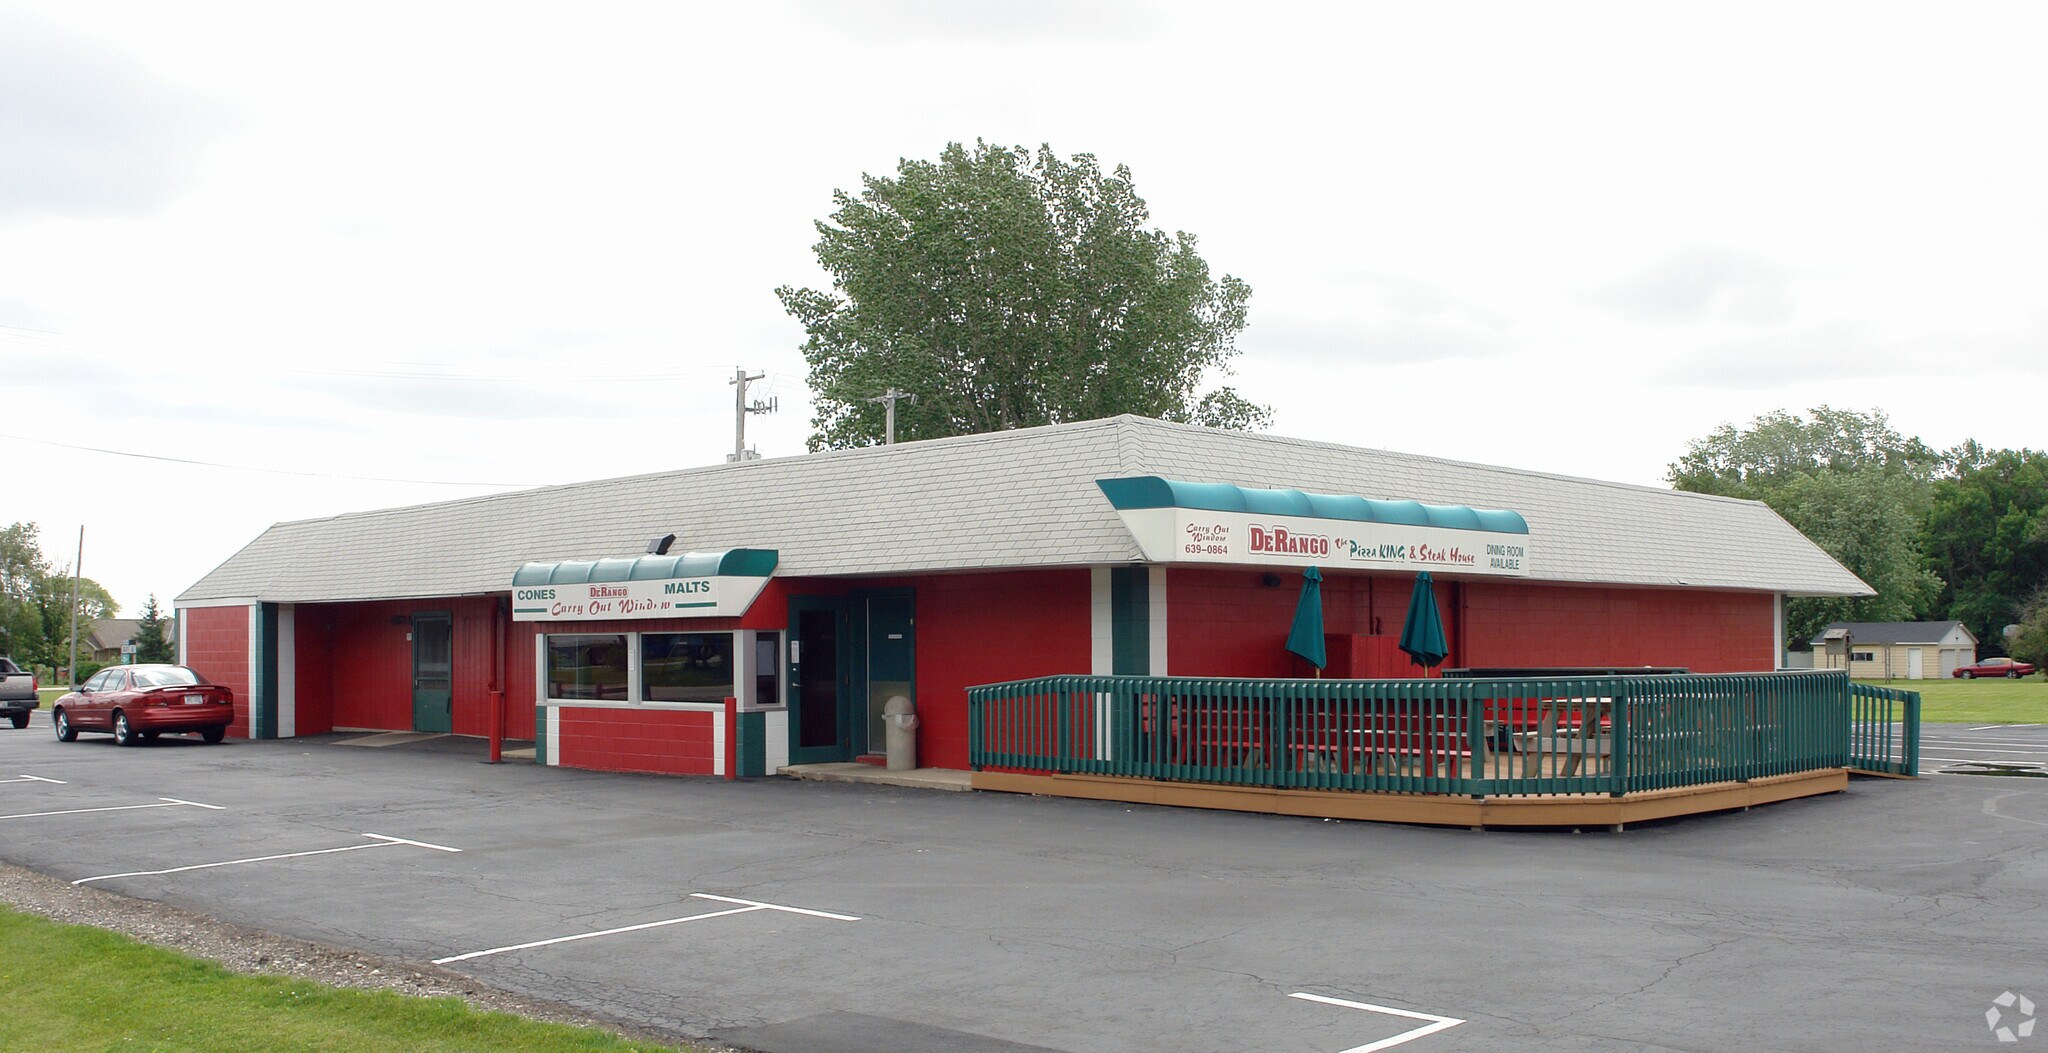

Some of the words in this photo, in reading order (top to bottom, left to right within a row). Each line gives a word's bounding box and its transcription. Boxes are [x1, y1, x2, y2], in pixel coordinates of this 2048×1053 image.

[1186, 523, 1210, 534] Carry
[1214, 524, 1229, 535] Out
[1192, 532, 1226, 542] Window
[1185, 543, 1228, 555] 639-0864
[1349, 539, 1377, 557] Pizza
[1379, 543, 1405, 560] KING
[1409, 545, 1417, 559] &
[1420, 543, 1446, 561] Steak
[1450, 546, 1475, 563] House
[1487, 544, 1505, 556] DINING
[1507, 545, 1524, 557] ROOM
[1490, 558, 1519, 570] AVAILABLE
[664, 581, 711, 595] MALTS
[517, 589, 556, 601] CONES
[551, 602, 583, 616] Carry
[589, 600, 612, 616] Out
